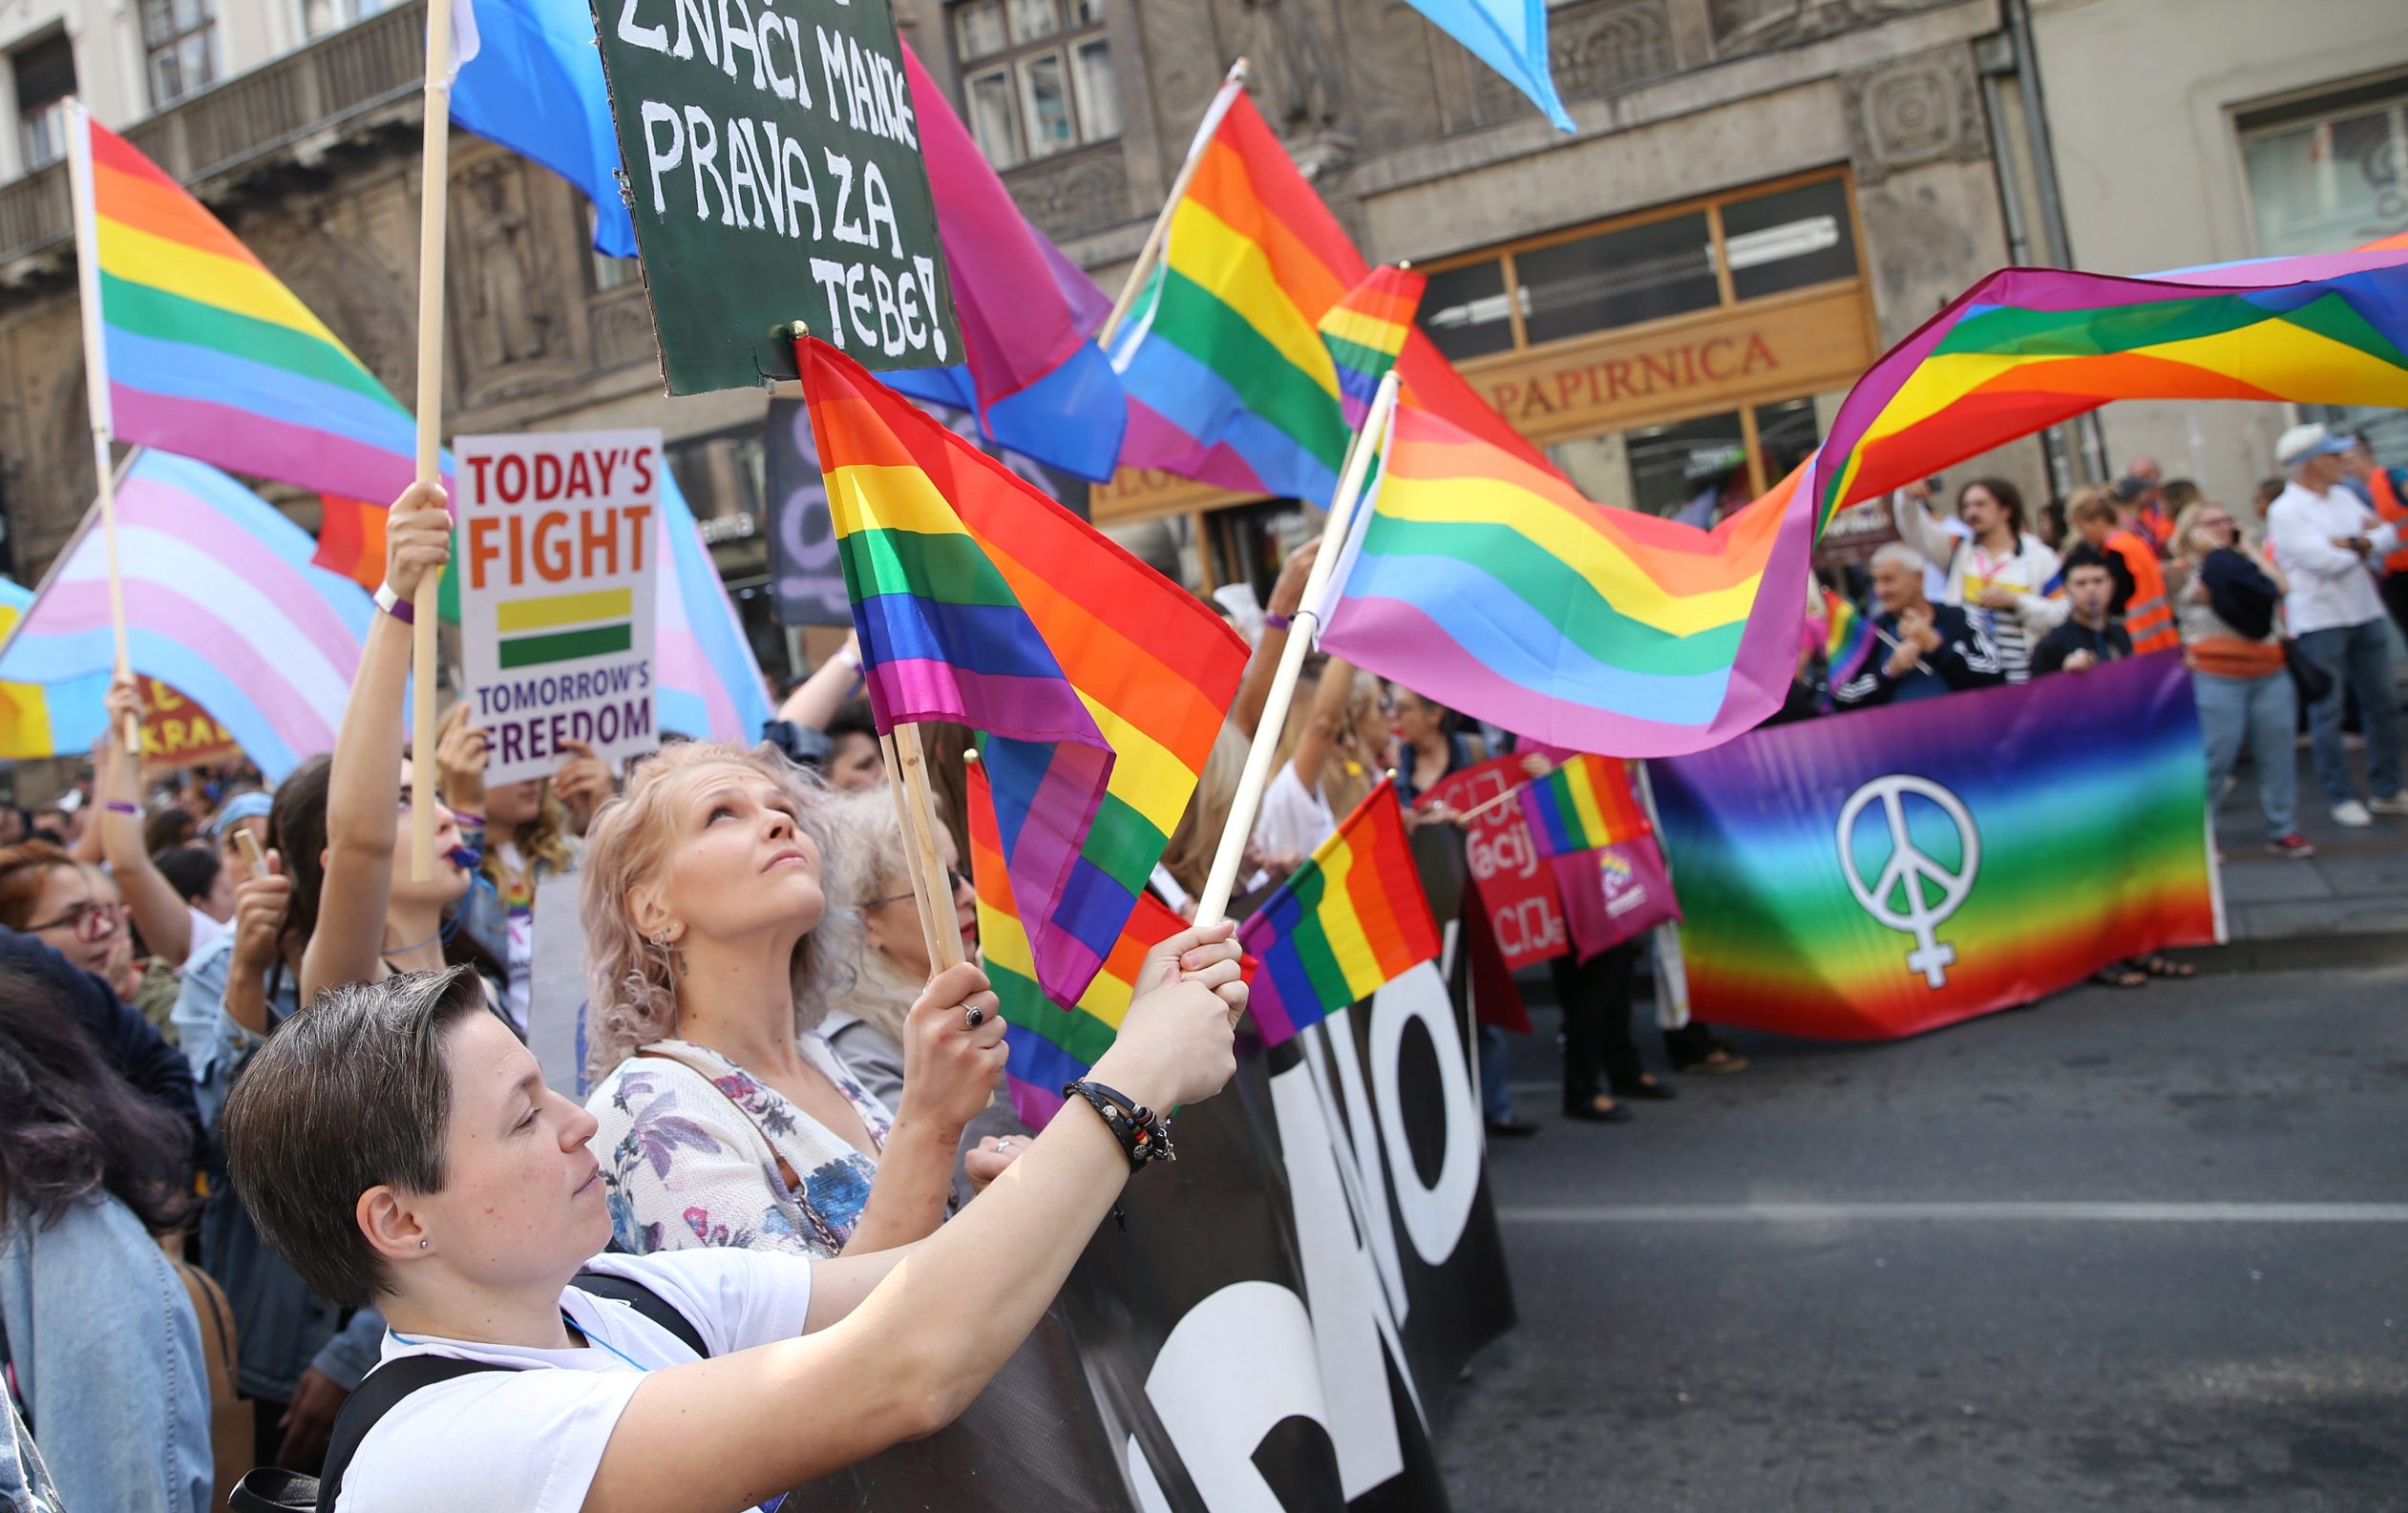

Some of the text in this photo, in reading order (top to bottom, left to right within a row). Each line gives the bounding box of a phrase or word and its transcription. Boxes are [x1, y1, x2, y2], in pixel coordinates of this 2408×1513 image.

[816, 25, 918, 151] MANJE
[642, 100, 903, 259] PRAVA ZA
[810, 255, 947, 362] TEBE!
[1493, 332, 1780, 420] PAPIRNICA
[467, 447, 652, 505] TODAY'S
[468, 506, 651, 589] FIGHT
